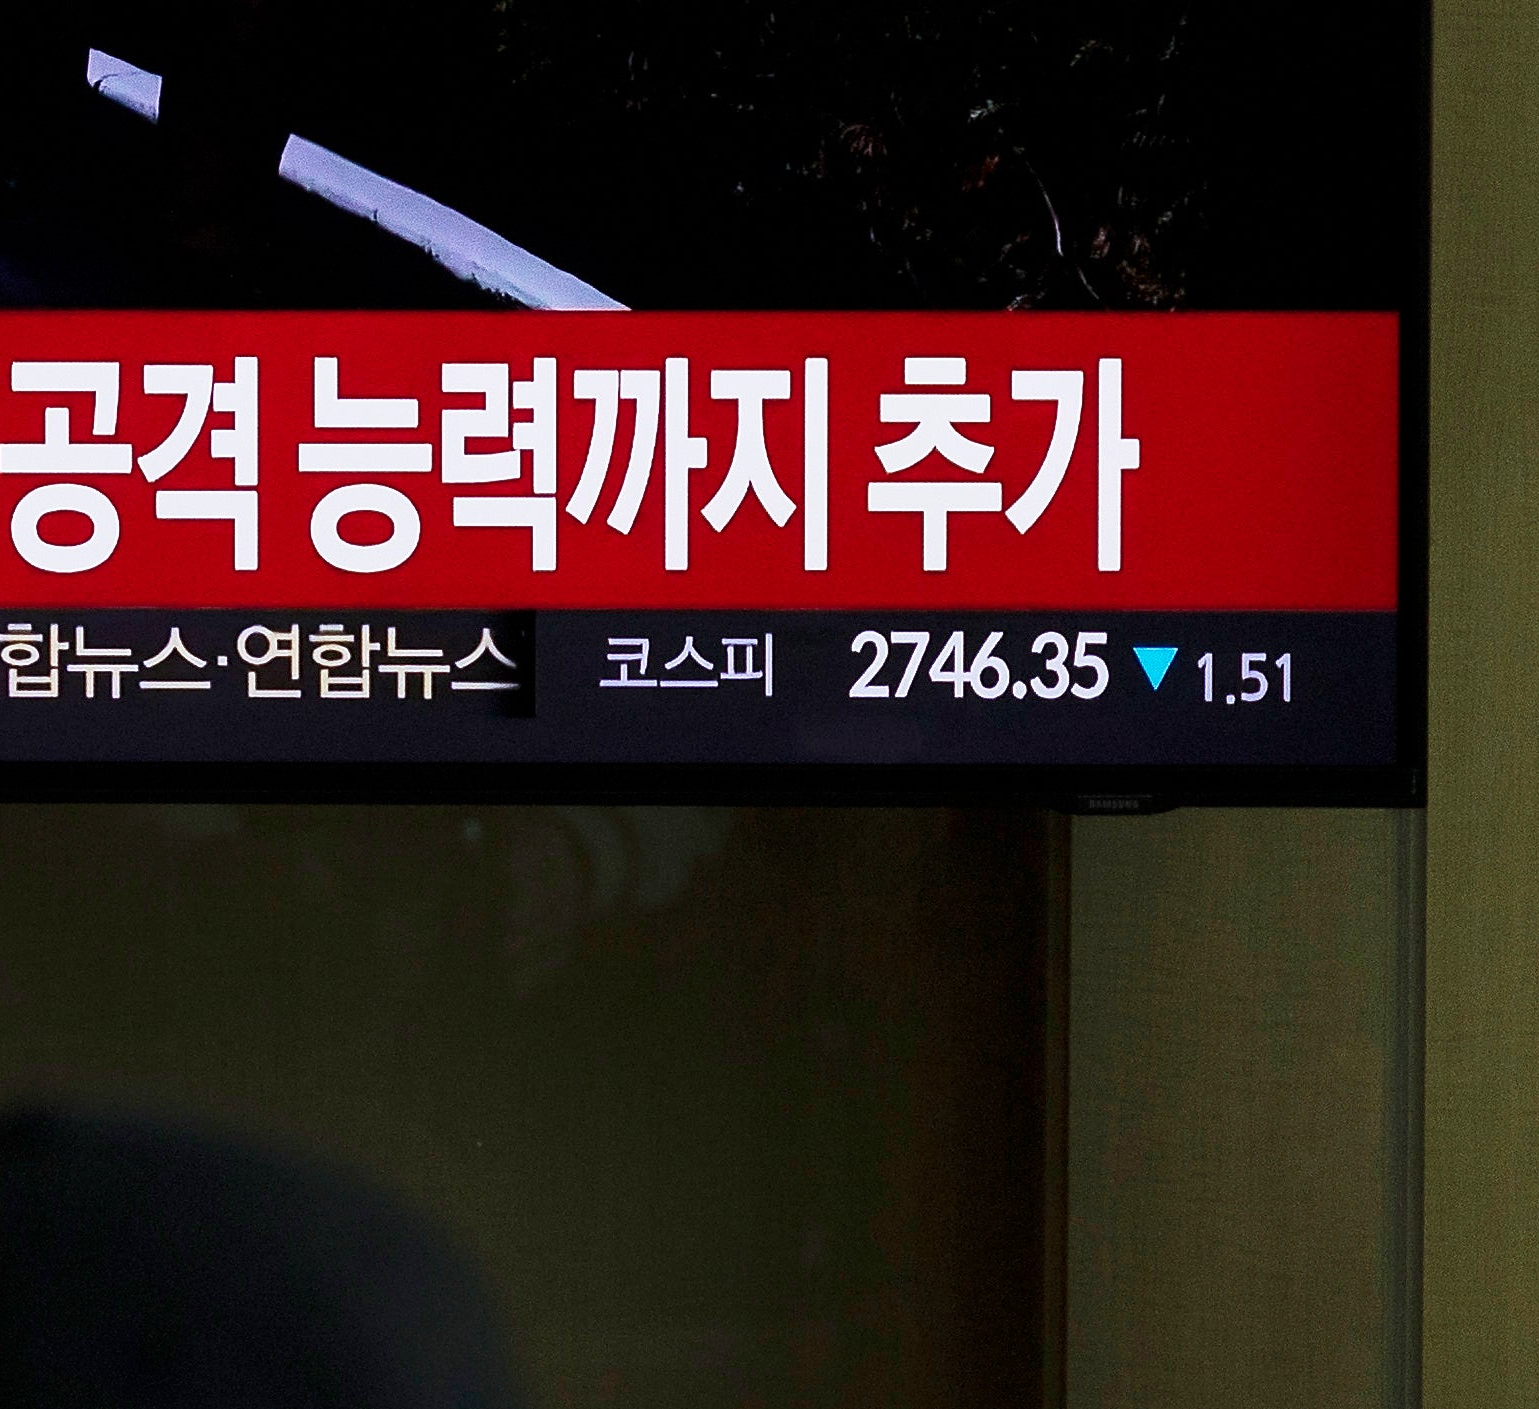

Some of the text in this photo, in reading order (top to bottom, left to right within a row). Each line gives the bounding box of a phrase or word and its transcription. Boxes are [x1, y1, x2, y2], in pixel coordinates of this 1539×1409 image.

[0, 356, 258, 574] 공격
[299, 356, 828, 574] 능력까지
[868, 357, 1140, 572] 추가
[599, 630, 1294, 705] 코스피 2746.35 1.51
